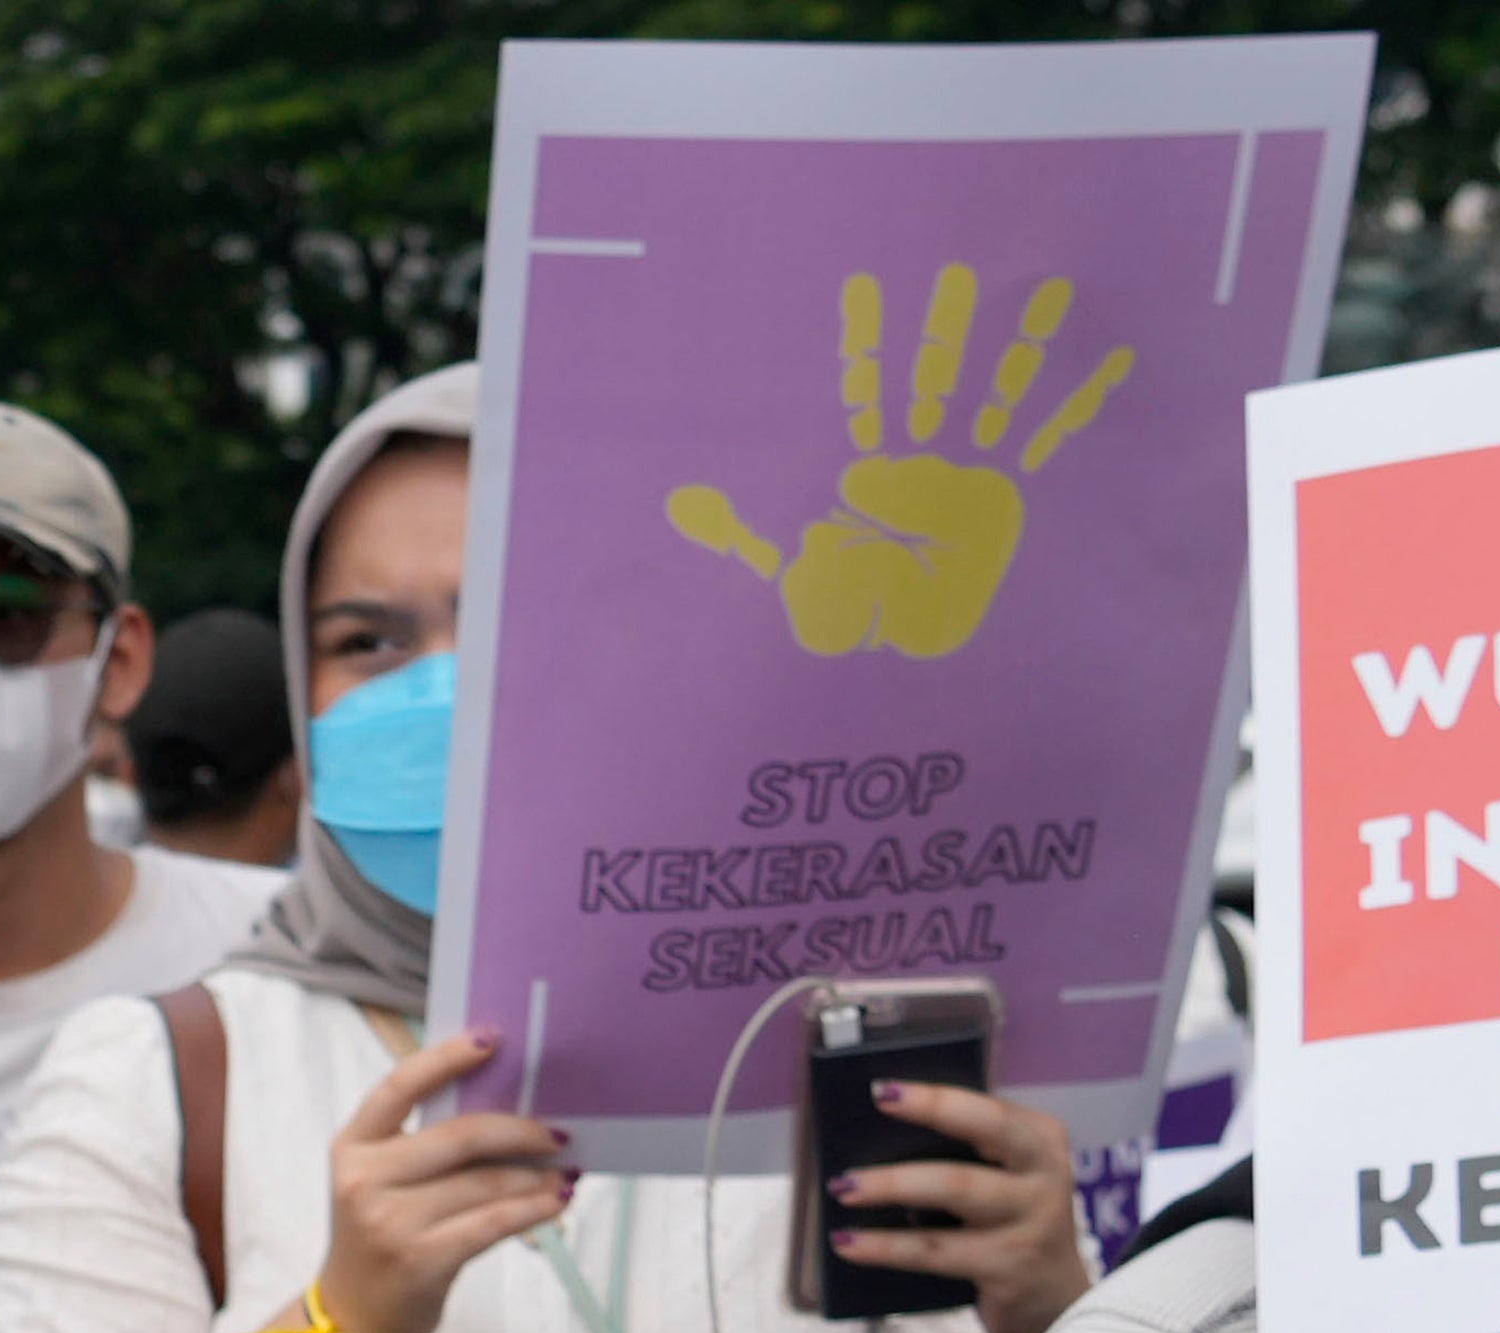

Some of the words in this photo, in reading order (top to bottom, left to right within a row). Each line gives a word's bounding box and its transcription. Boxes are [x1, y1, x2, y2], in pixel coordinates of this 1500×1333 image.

[741, 751, 964, 828] STOP
[580, 818, 1096, 914] KEKERASAN
[642, 903, 1006, 993] SEKSUAL
